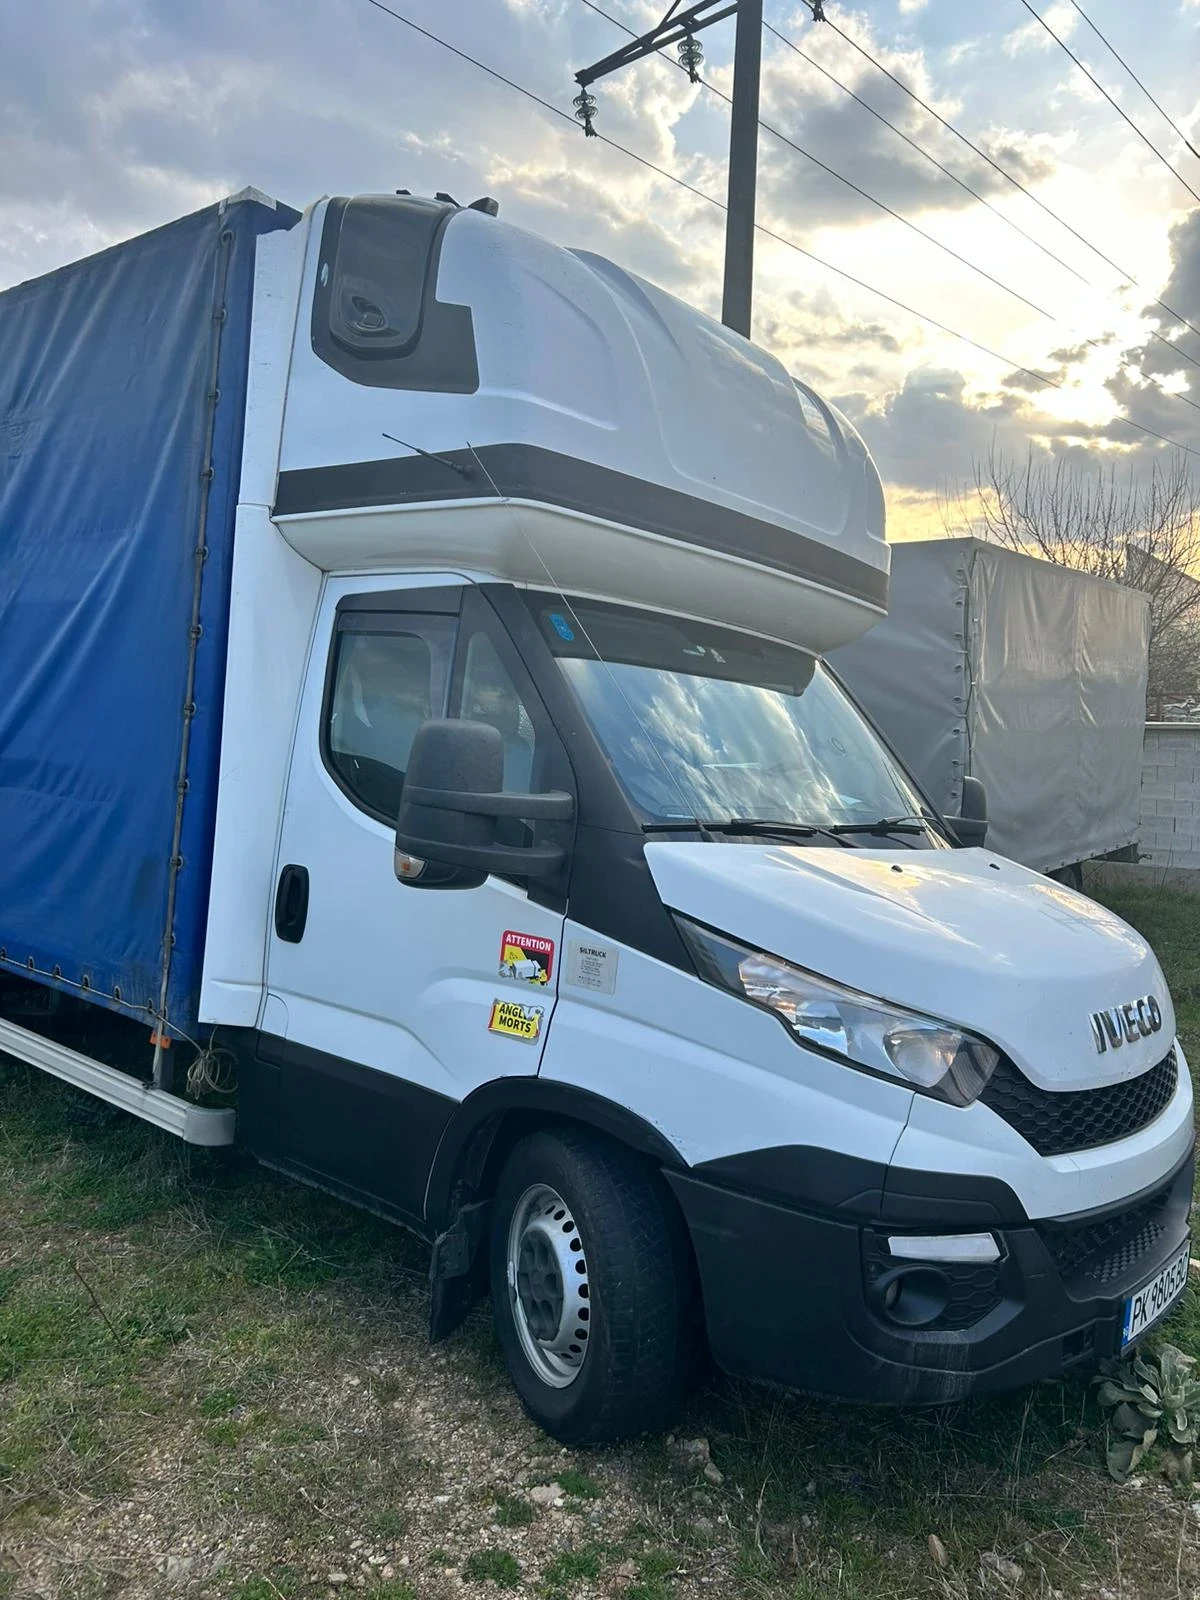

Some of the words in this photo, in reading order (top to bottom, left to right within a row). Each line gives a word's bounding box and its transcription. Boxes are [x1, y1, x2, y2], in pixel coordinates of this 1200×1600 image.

[506, 934, 551, 951] ATTENTION
[579, 947, 607, 958] SILTRUCK
[499, 1003, 537, 1021] ANGL
[499, 1015, 532, 1033] MORTS
[1088, 995, 1162, 1054] IVECO
[1131, 1288, 1150, 1333] PK
[1151, 1264, 1177, 1316] 9805
